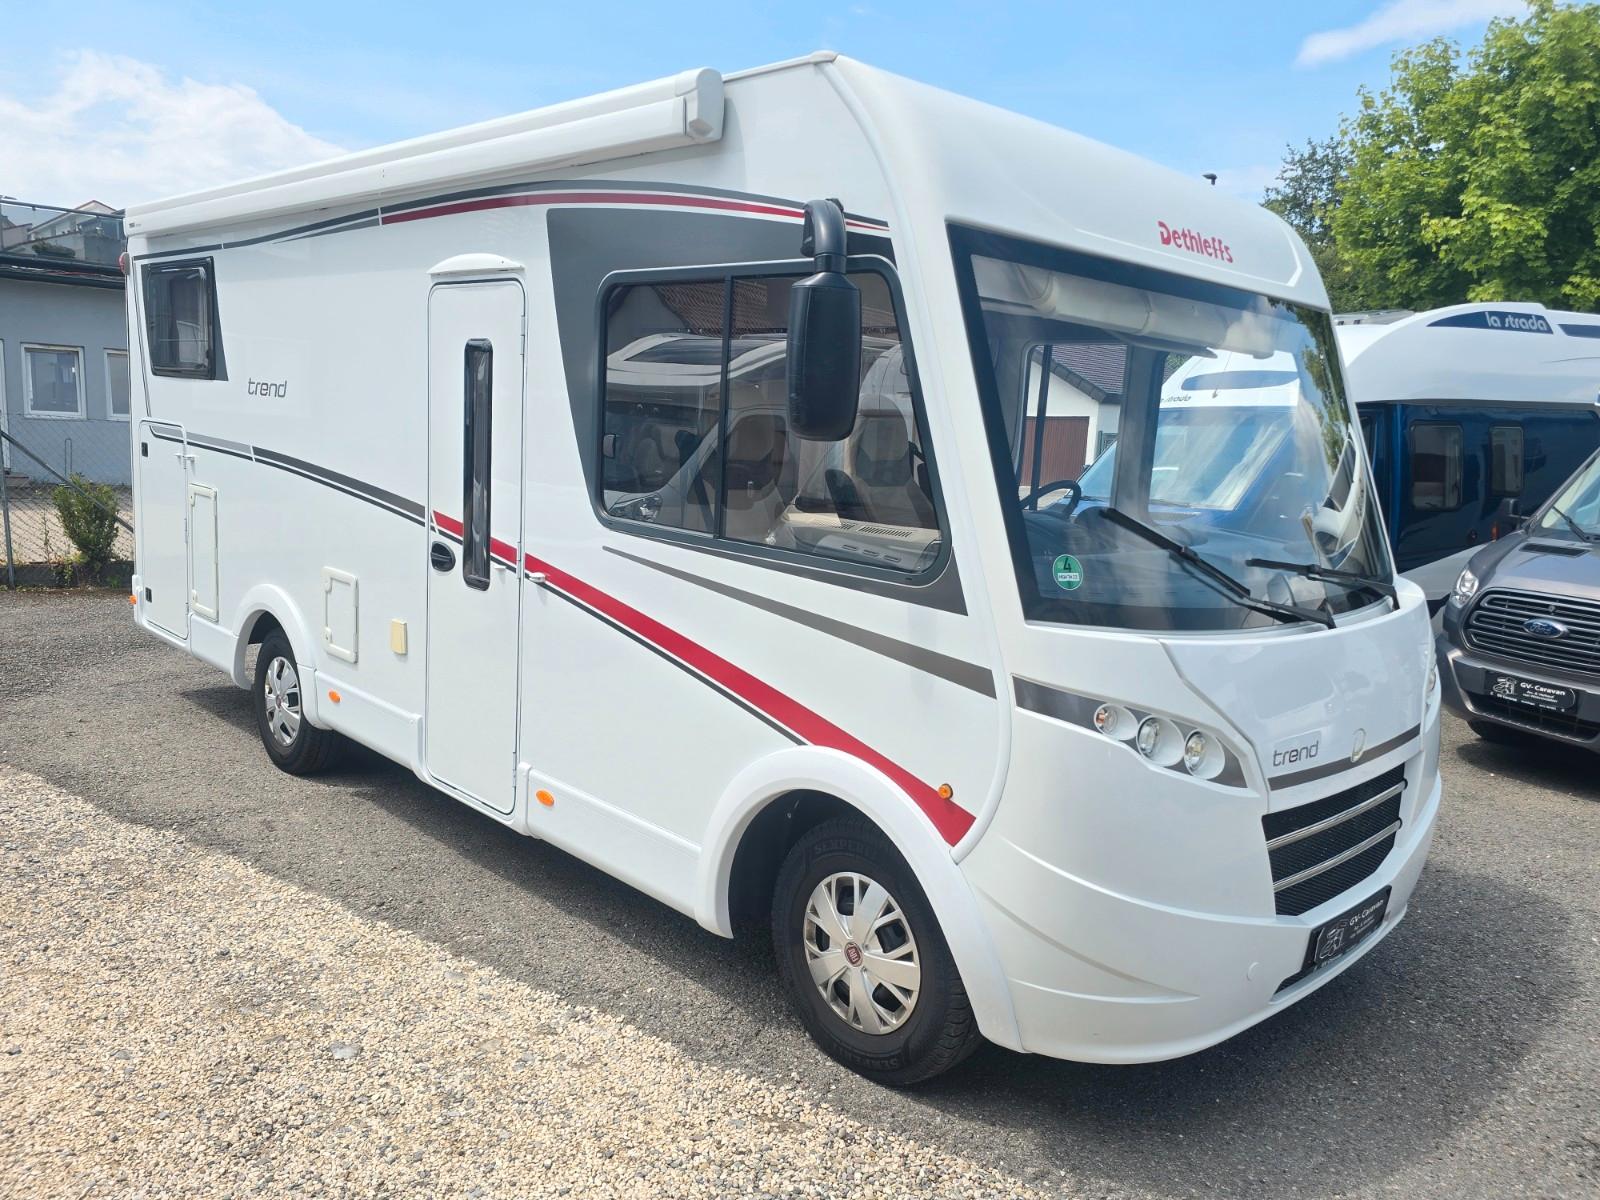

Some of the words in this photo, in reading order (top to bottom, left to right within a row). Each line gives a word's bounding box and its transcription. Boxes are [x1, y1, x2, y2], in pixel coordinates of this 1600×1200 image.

[1158, 220, 1233, 263] Dethleffs
[1485, 311, 1500, 327] la
[1504, 314, 1547, 330] strada
[247, 377, 288, 398] trend
[1063, 557, 1072, 573] 4
[1535, 685, 1566, 696] Caravan
[1272, 740, 1319, 767] trend
